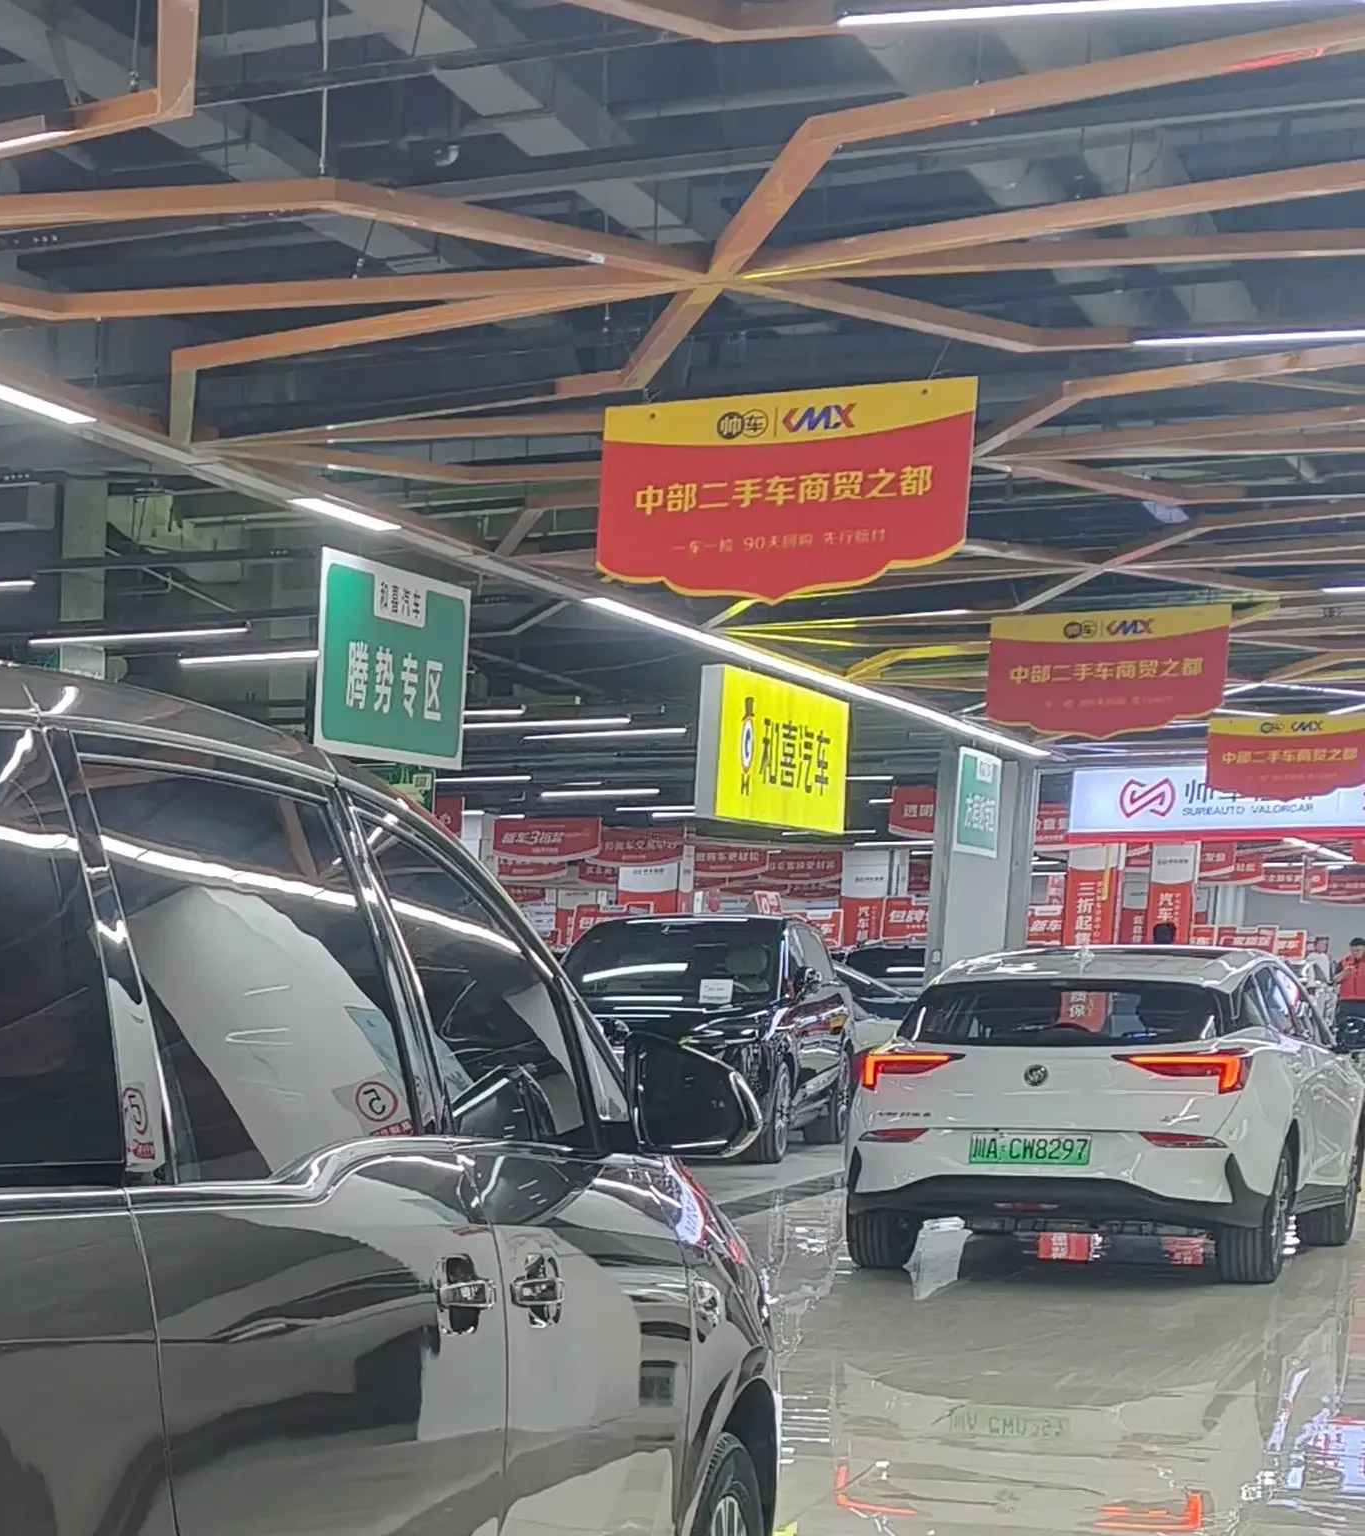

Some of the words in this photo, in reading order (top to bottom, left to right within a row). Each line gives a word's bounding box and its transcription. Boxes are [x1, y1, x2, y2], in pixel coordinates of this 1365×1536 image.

[635, 464, 934, 515] 中部二手车商贸之都
[1010, 656, 1204, 685] 中部二手车商贸之都
[759, 716, 832, 797] 和喜汽车
